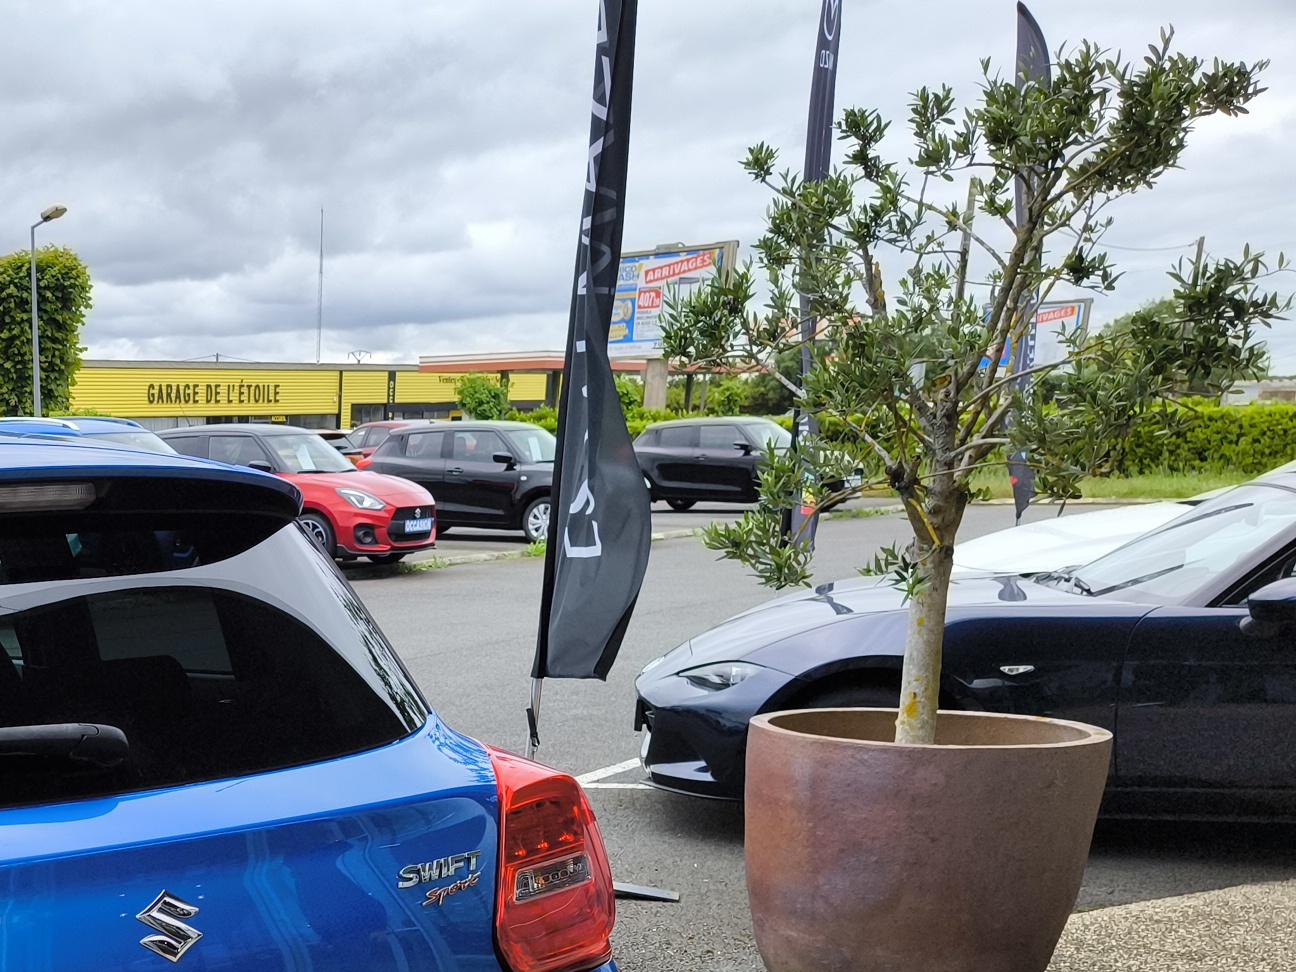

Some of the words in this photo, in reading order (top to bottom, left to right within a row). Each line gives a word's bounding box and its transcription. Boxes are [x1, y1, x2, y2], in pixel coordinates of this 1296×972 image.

[646, 253, 711, 282] ARRIVAGES
[147, 383, 200, 404] GARAGE
[205, 383, 221, 403] DE
[227, 378, 281, 403] L'ÉTOILE
[397, 849, 482, 889] SWIFT
[422, 871, 482, 907] Sport
